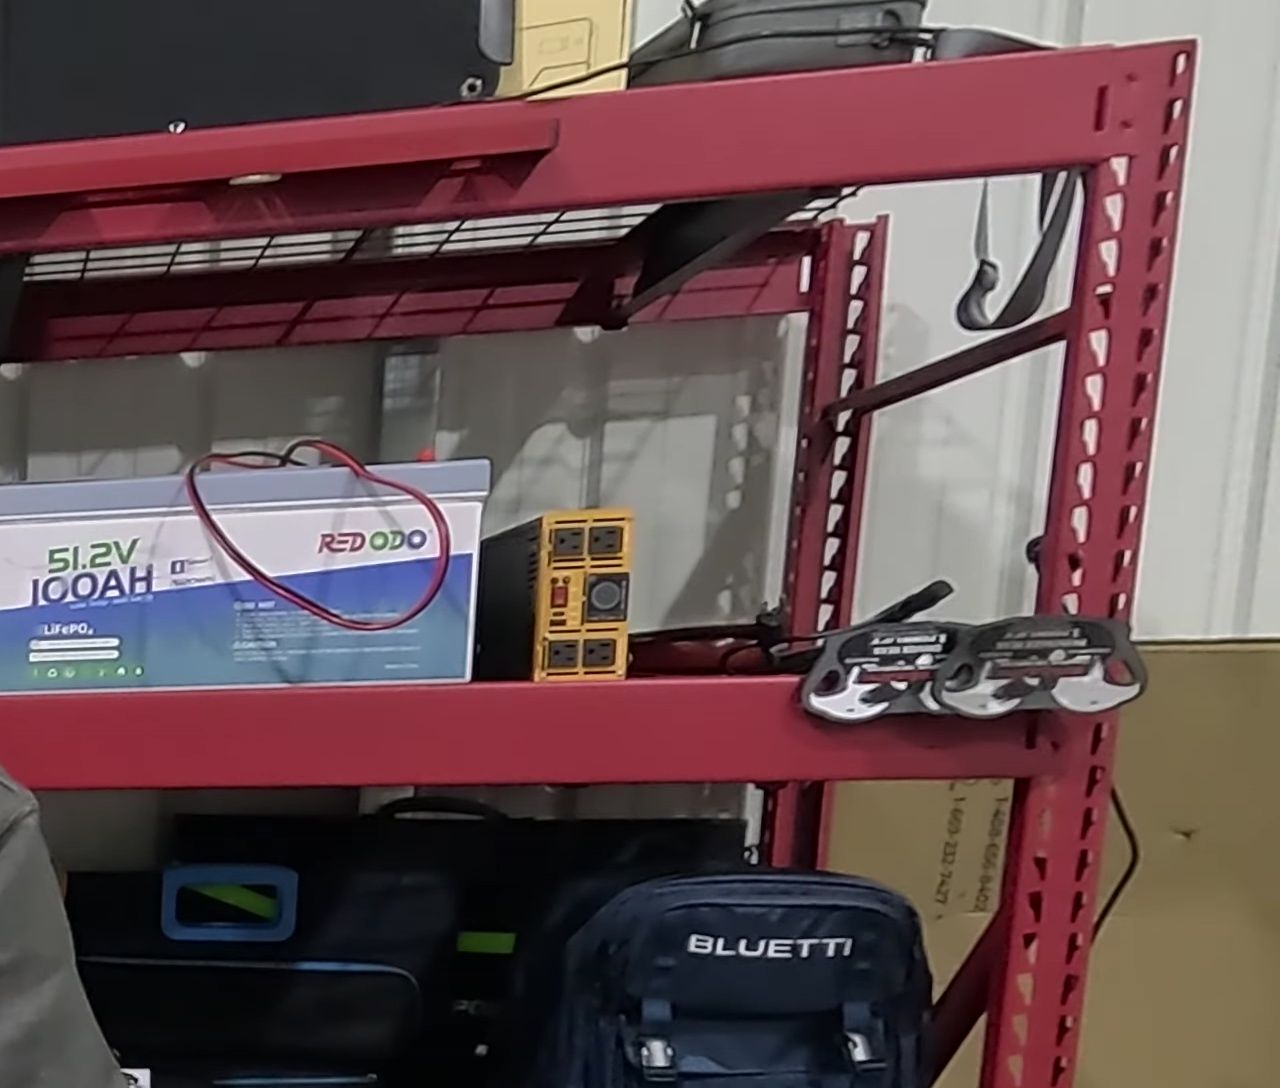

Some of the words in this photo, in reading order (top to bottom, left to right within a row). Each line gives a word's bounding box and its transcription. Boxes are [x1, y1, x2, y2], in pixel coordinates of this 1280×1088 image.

[48, 538, 140, 574] 51.2V
[31, 564, 154, 606] 100AH
[687, 933, 853, 958] BLUETTI
